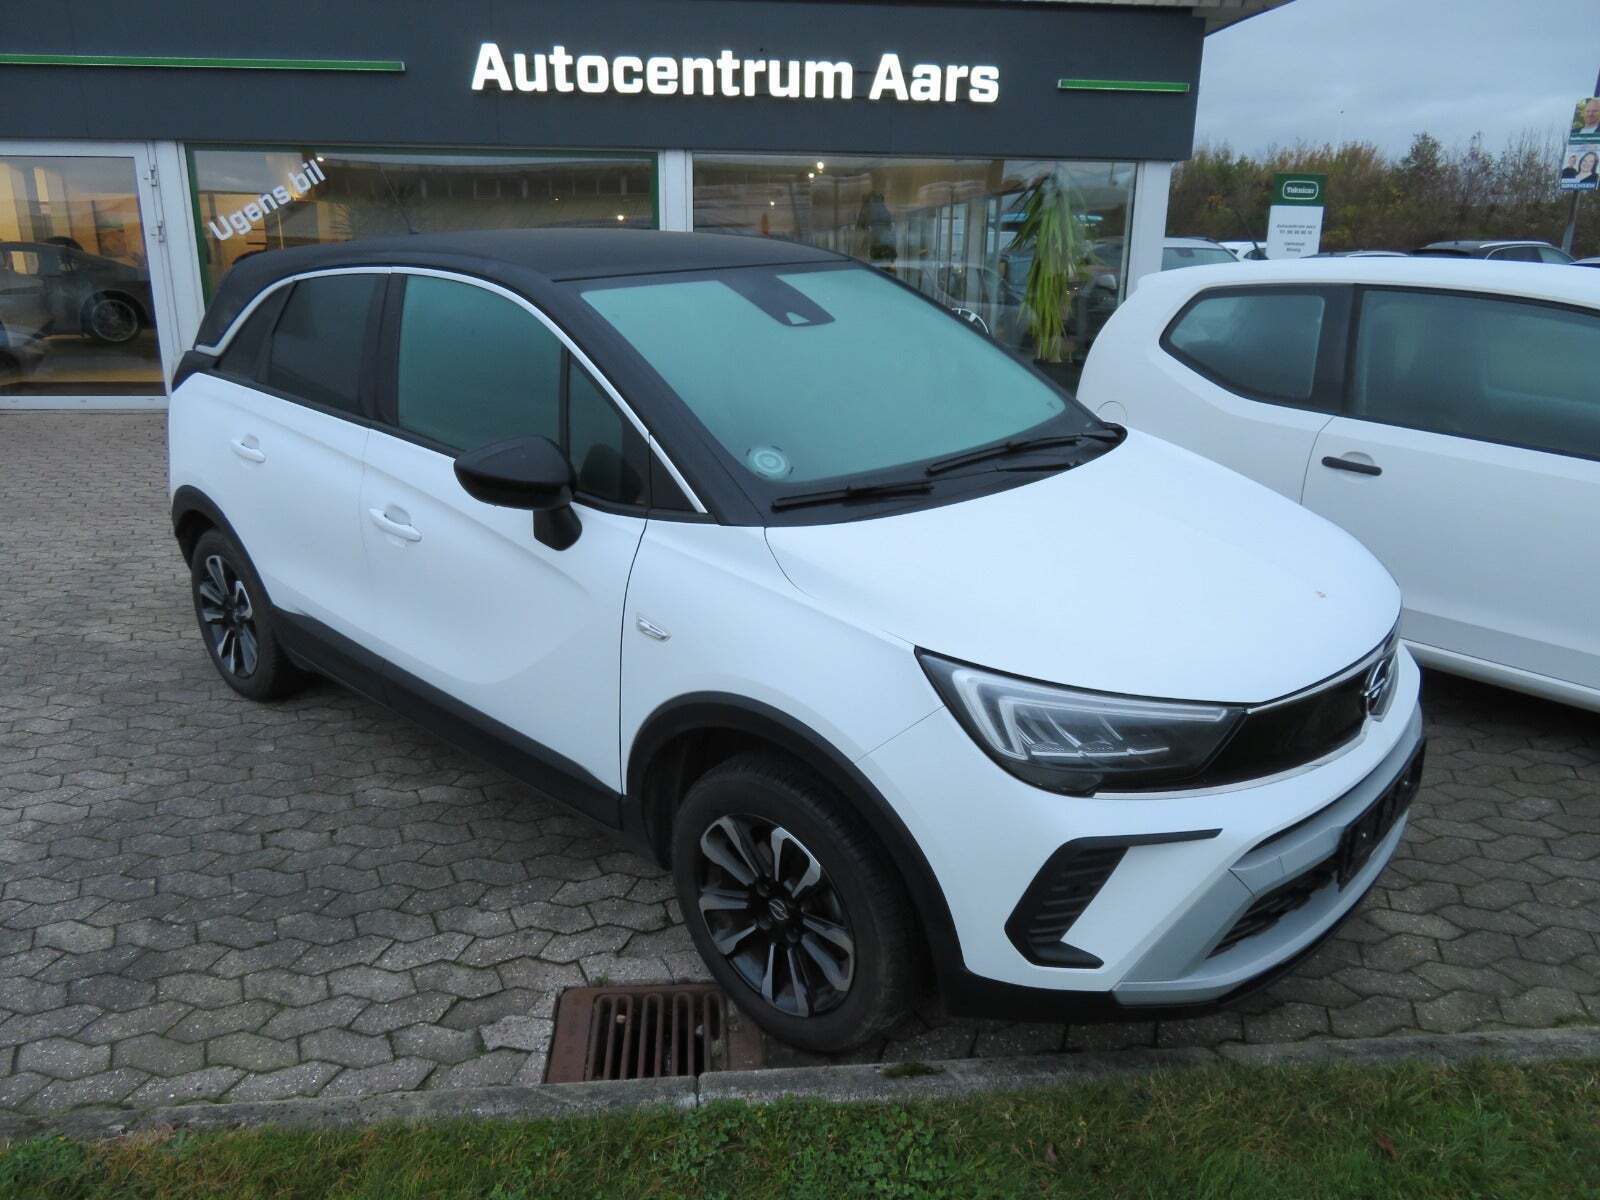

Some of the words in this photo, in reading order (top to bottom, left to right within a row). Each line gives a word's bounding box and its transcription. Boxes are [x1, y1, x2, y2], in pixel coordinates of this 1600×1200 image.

[471, 42, 854, 99] Autocentrum
[869, 53, 1001, 103] Aars
[208, 185, 291, 240] Ugens
[288, 159, 325, 193] bil
